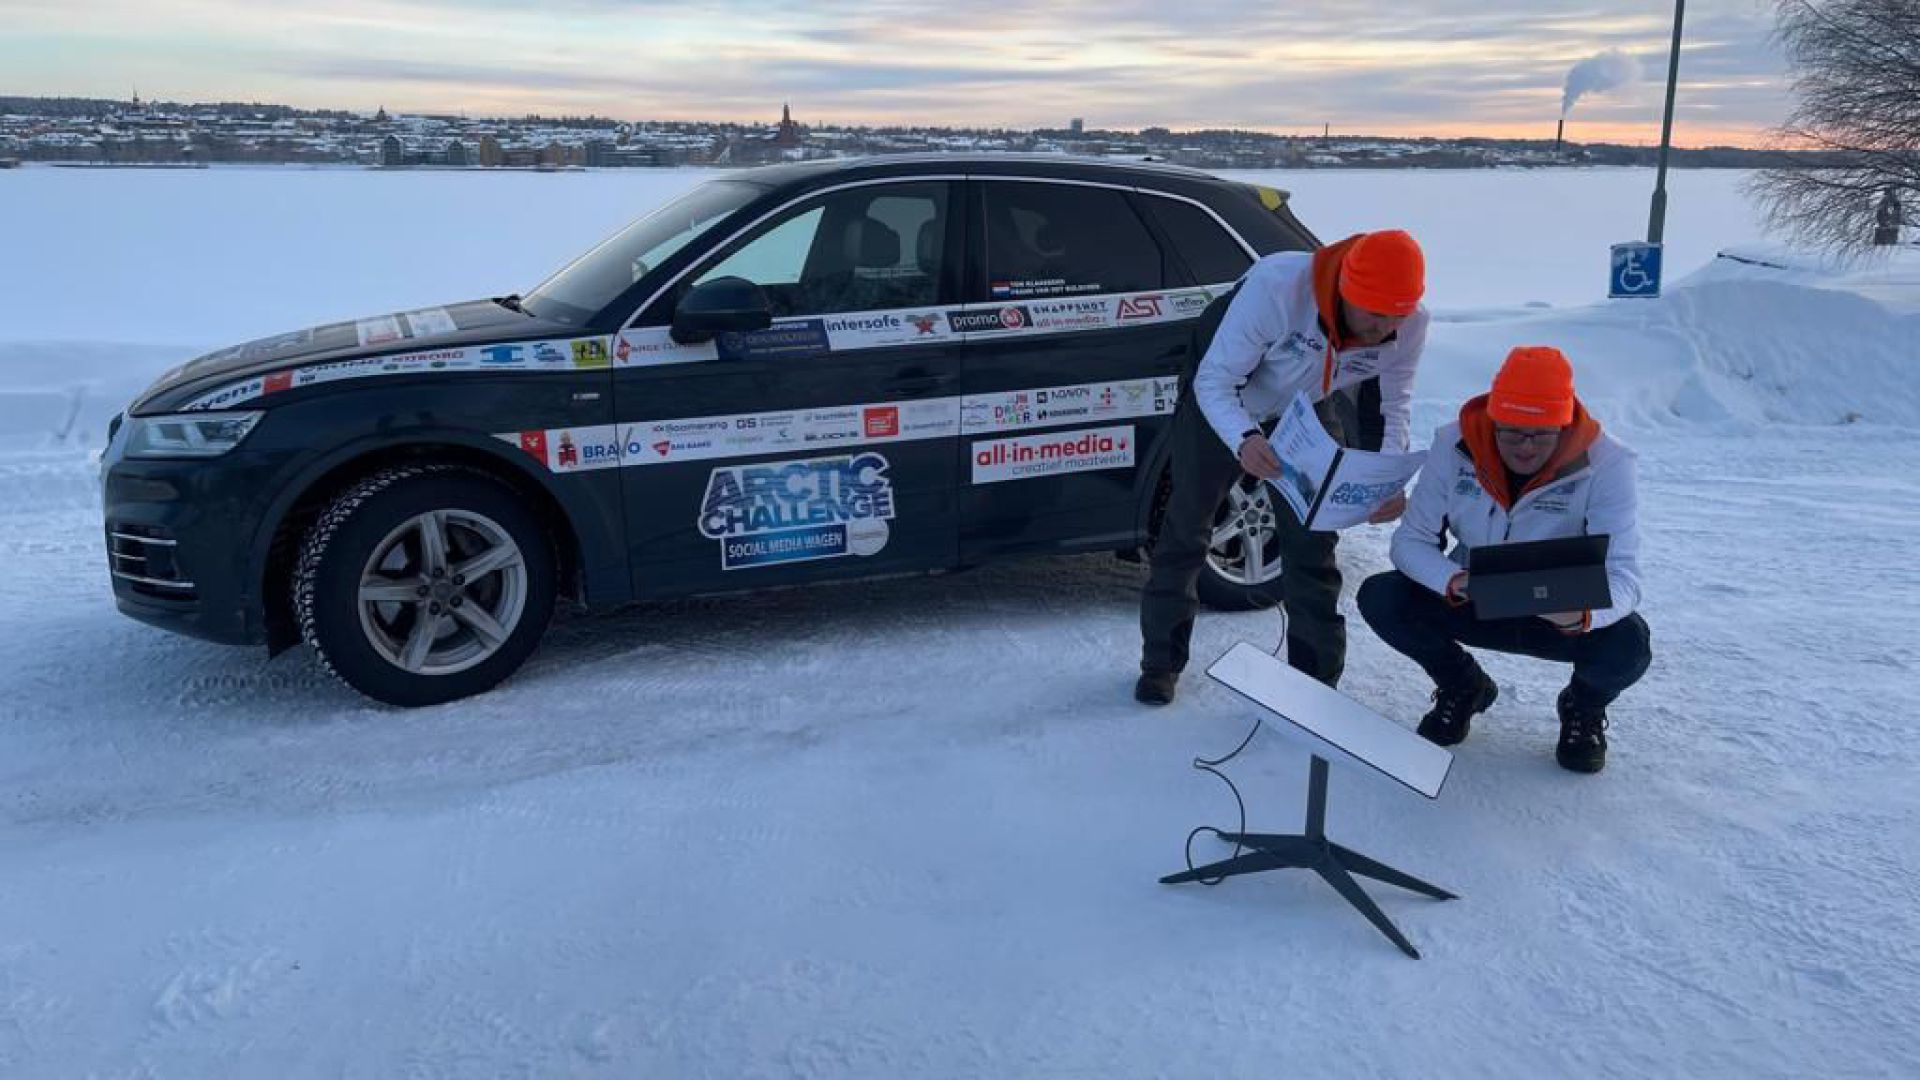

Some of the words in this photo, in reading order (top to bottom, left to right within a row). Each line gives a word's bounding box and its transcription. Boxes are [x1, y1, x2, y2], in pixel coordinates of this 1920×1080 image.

[1116, 295, 1165, 320] AST
[826, 314, 899, 331] intersafe
[953, 314, 998, 329] promo
[583, 427, 641, 458] BRAVO
[1012, 457, 1063, 476] creatief
[1065, 451, 1128, 469] maatwerk
[703, 453, 889, 512] ARCTIC
[701, 488, 893, 537] CHALLENGE
[728, 542, 767, 559] SOCIAL
[769, 536, 805, 555] MEDIA
[805, 531, 843, 550] WAGEN
